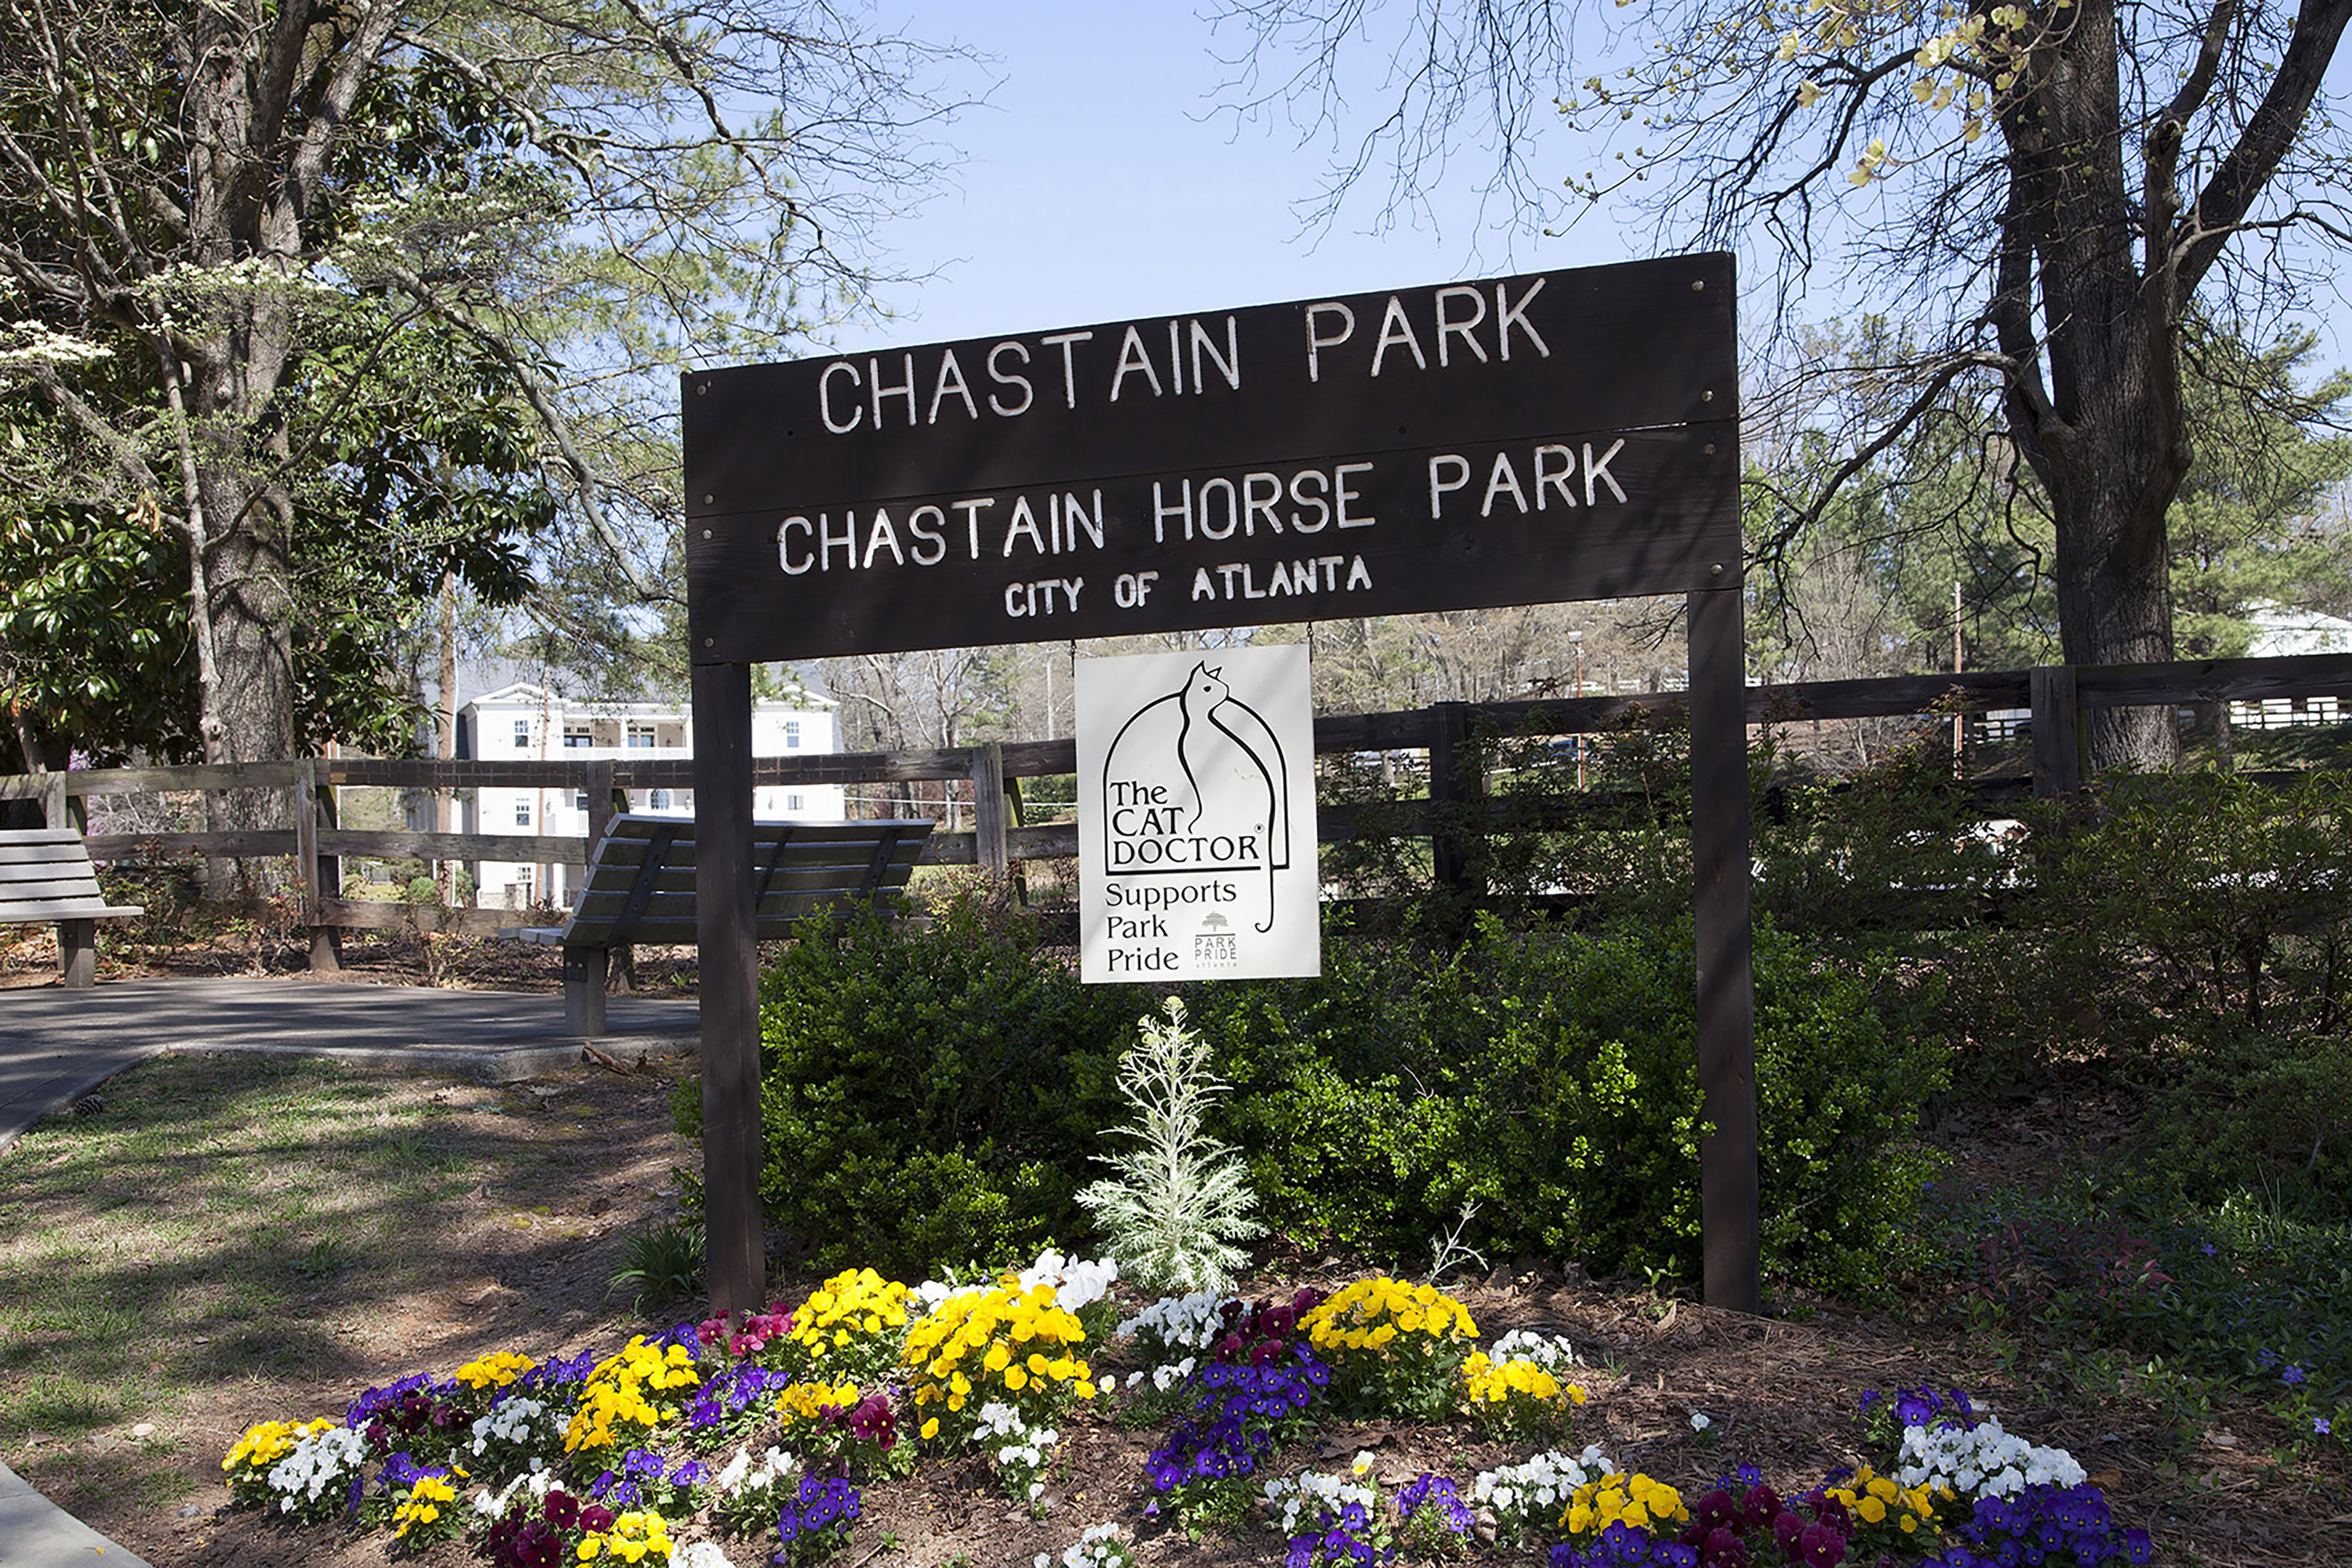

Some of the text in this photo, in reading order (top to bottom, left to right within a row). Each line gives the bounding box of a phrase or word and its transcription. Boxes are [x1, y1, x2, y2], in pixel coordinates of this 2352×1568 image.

[819, 277, 1549, 433] CHASTAIN PARK
[778, 439, 1626, 574] CHASTAIN HORSE PARK
[1006, 555, 1371, 617] CITY OF ATLANTA
[1110, 781, 1167, 805] The
[1113, 807, 1184, 836] CAT
[1114, 836, 1259, 865] DOCTOR
[1106, 880, 1236, 911] Supports
[1108, 914, 1167, 938] Park
[1195, 937, 1236, 949] PARK
[1195, 948, 1237, 960] PRIDE
[1109, 947, 1178, 971] Pride
